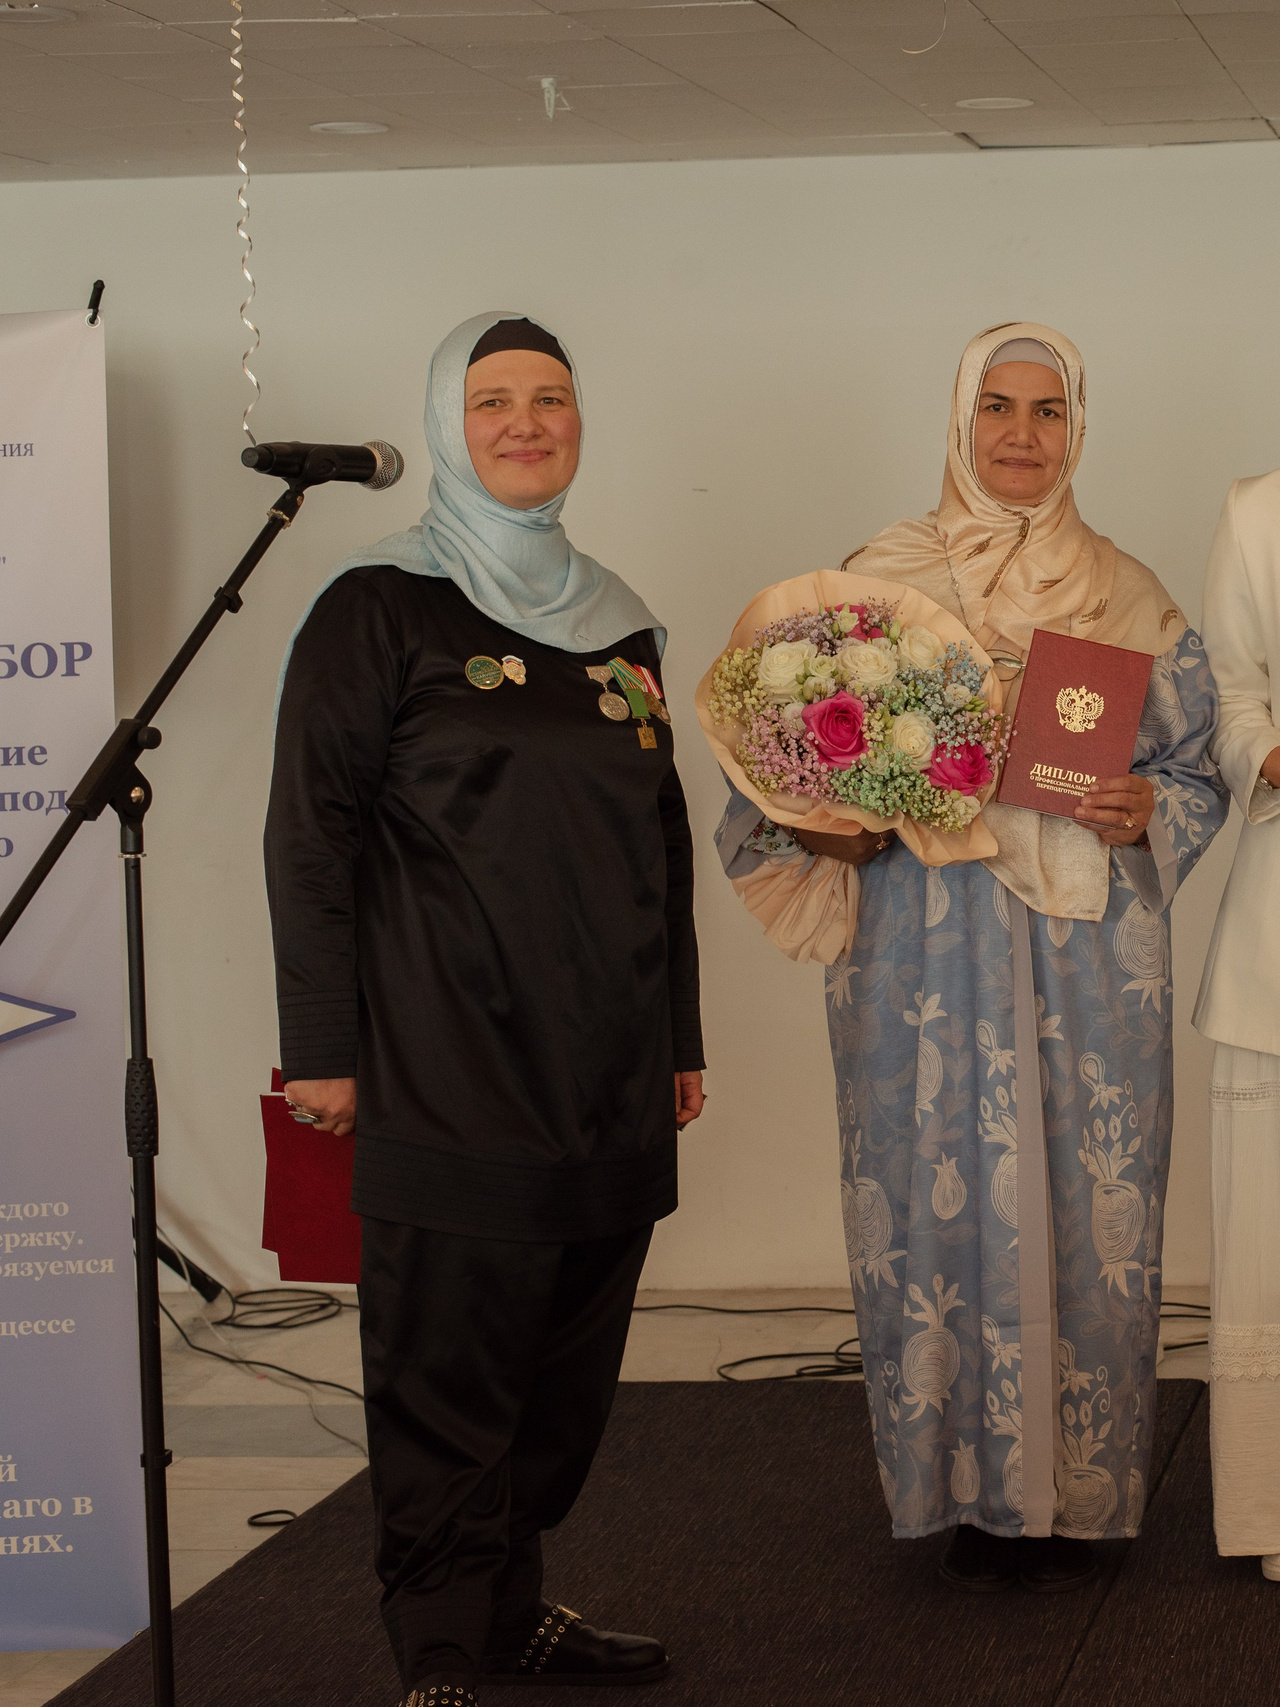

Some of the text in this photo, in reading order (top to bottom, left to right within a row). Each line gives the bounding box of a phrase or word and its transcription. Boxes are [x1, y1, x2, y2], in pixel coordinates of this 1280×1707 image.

[0, 641, 93, 679] БОР
[0, 744, 48, 767] ие
[1029, 763, 1097, 785] ДИПЛОМ
[1035, 776, 1090, 792] ПРОФЕССИОНАЛЬНО
[0, 1201, 69, 1221] дого
[0, 1230, 84, 1254] ржку.
[0, 1258, 115, 1281] язуемся
[0, 1496, 93, 1519] аго в
[0, 1534, 74, 1555] нях.
